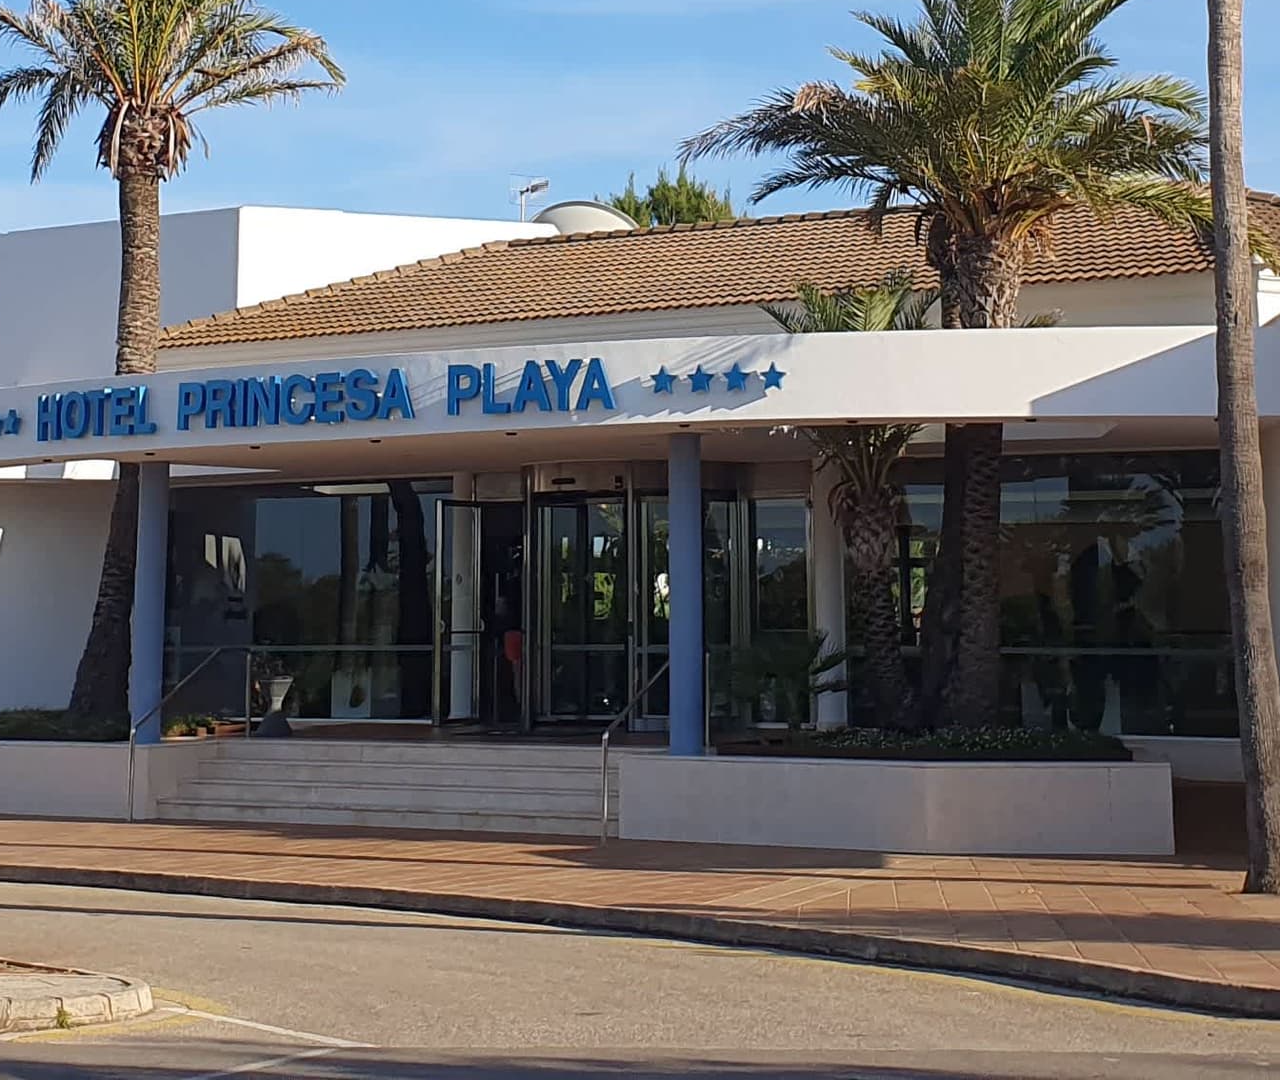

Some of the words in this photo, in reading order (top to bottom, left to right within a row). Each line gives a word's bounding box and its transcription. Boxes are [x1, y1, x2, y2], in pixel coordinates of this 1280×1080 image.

[36, 384, 156, 441] HOTEL
[177, 368, 416, 431] PRINCESA
[446, 358, 616, 416] PLAYA
